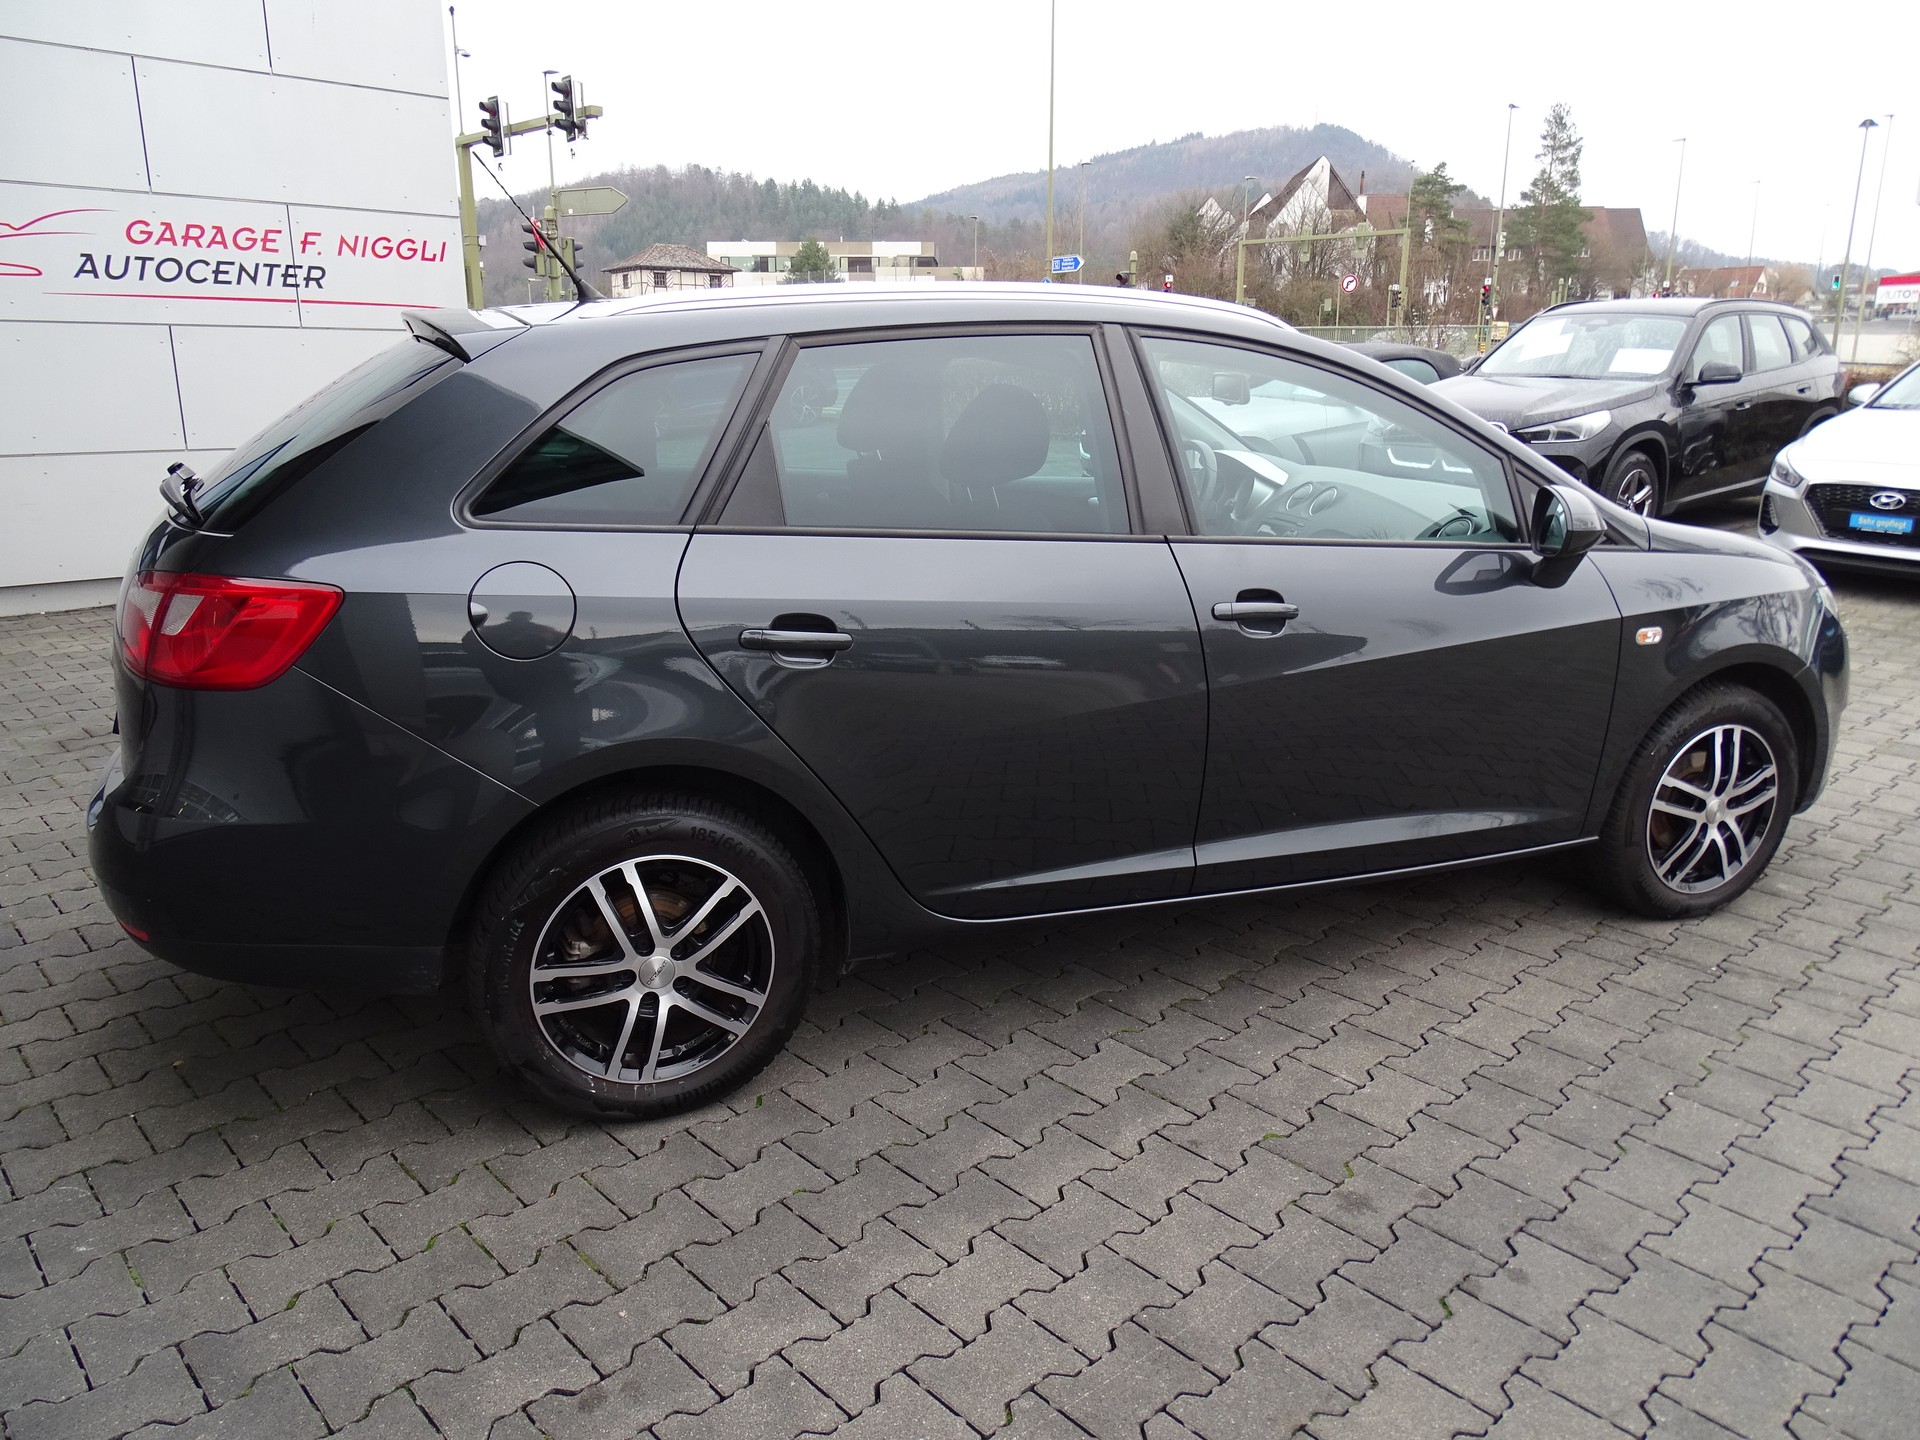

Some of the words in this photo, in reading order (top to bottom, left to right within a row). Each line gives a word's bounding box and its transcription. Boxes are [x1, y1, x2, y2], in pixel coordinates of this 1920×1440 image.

[125, 219, 283, 253] GARAGE
[300, 231, 323, 256] F.
[337, 235, 448, 263] NIGGLI
[73, 253, 326, 290] AUTOCENTER
